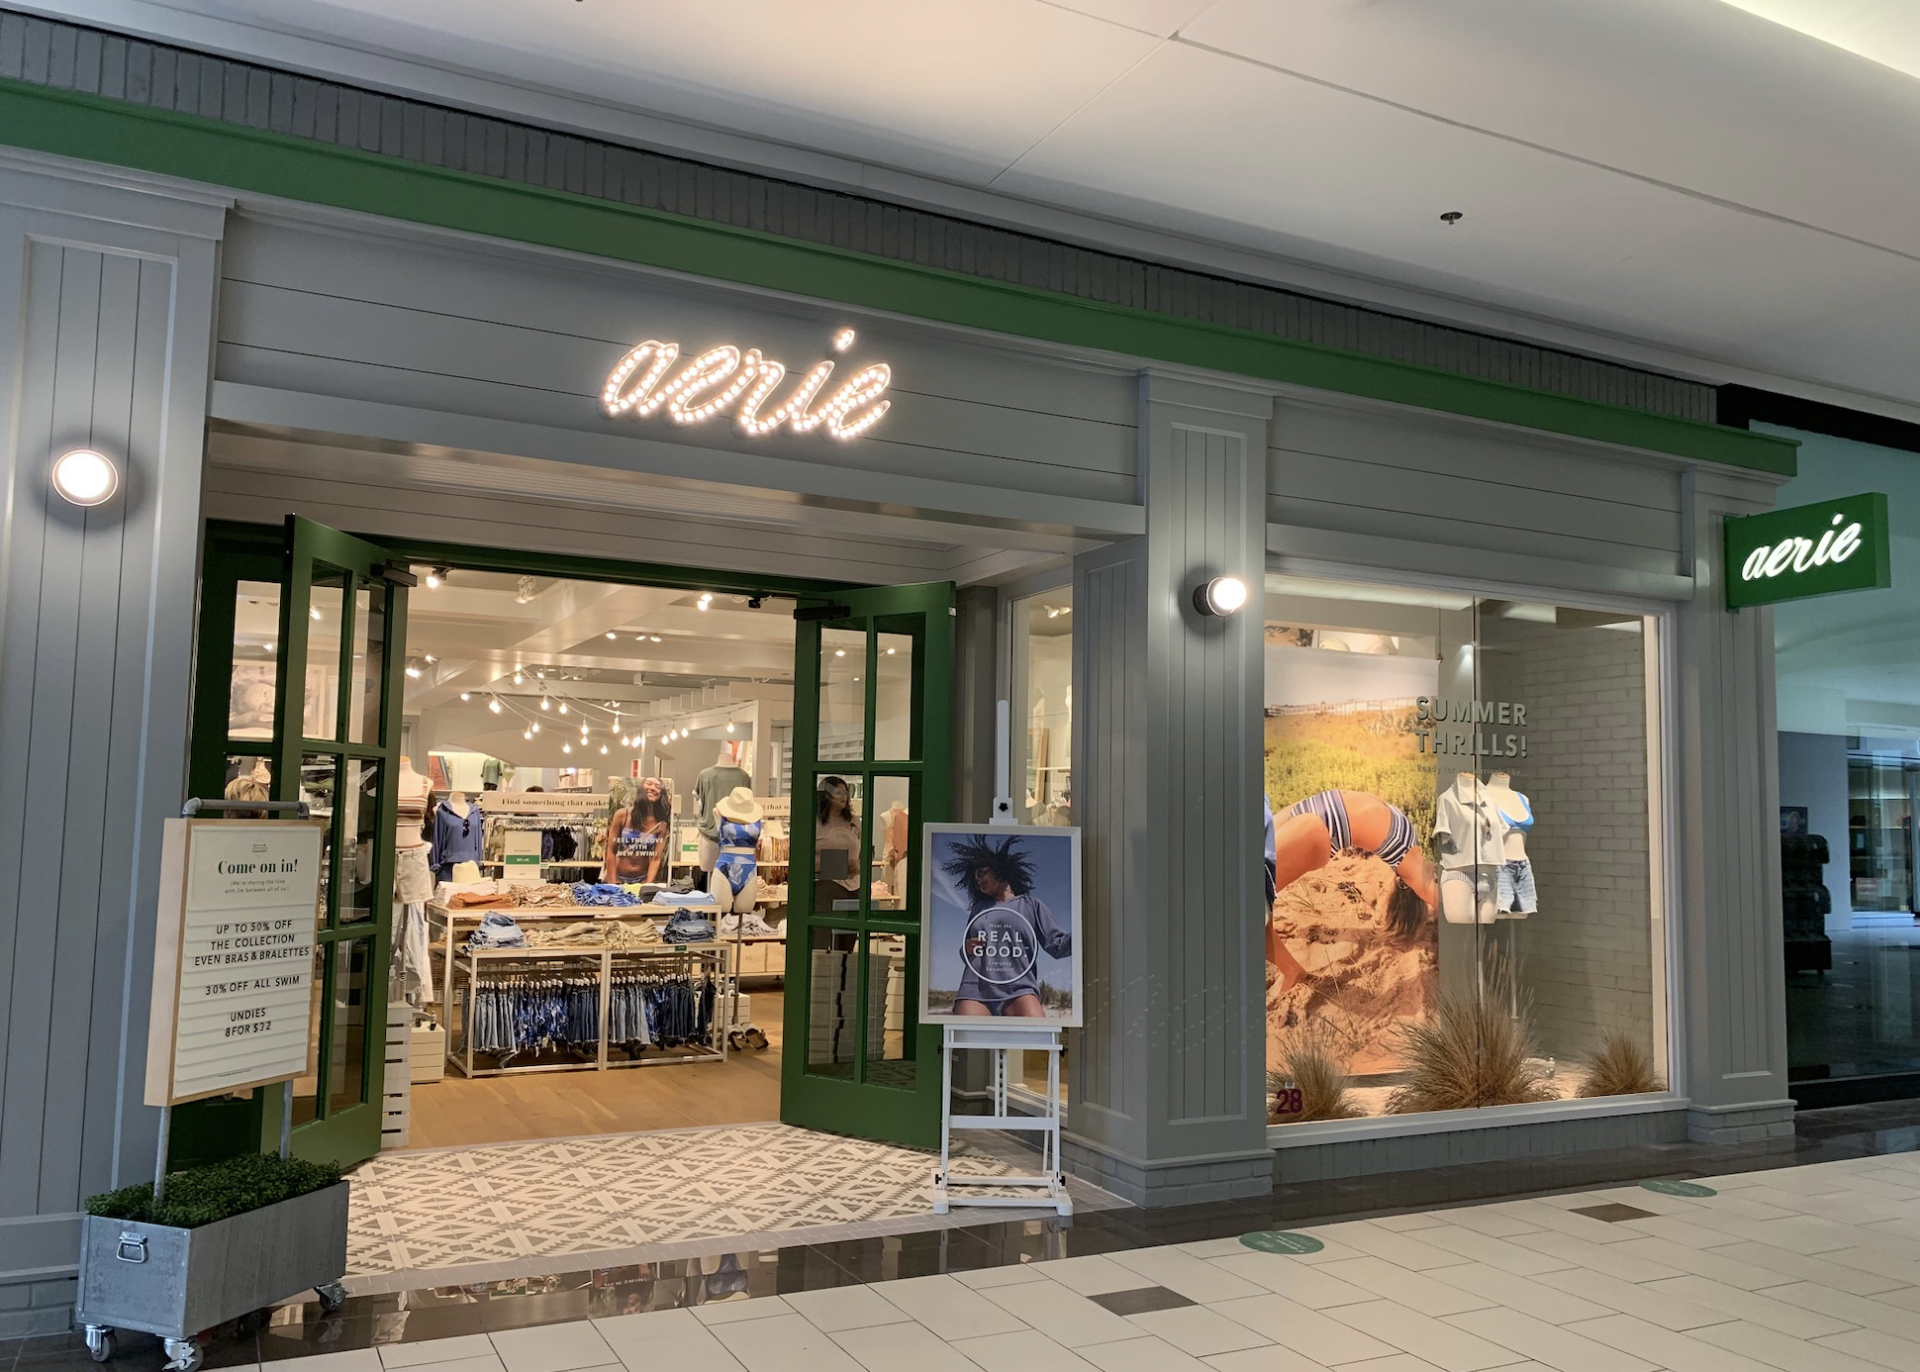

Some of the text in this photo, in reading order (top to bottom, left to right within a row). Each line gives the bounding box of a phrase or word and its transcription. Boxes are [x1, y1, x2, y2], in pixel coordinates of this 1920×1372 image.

[604, 329, 892, 439] aerie
[1741, 513, 1863, 582] aerie
[1415, 696, 1528, 727] SUMMER
[1414, 728, 1528, 759] THRILLS!
[1416, 764, 1440, 775] Ready
[1444, 765, 1456, 774] for
[1477, 765, 1505, 775] rrivals
[522, 799, 565, 807] something
[218, 858, 298, 875] Come on in!
[216, 920, 293, 935] UP TO 50% OFF
[211, 934, 295, 950] THE COLLECTION
[977, 930, 1022, 942] REAL
[194, 946, 310, 966] EVEN BRAS & BRALETTES
[973, 945, 1028, 958] GOOD.
[205, 975, 300, 996] 30% OFF ALL SWIM
[230, 1007, 267, 1022] UNDIES
[253, 1020, 272, 1033] $32
[1276, 1088, 1303, 1114] 28
